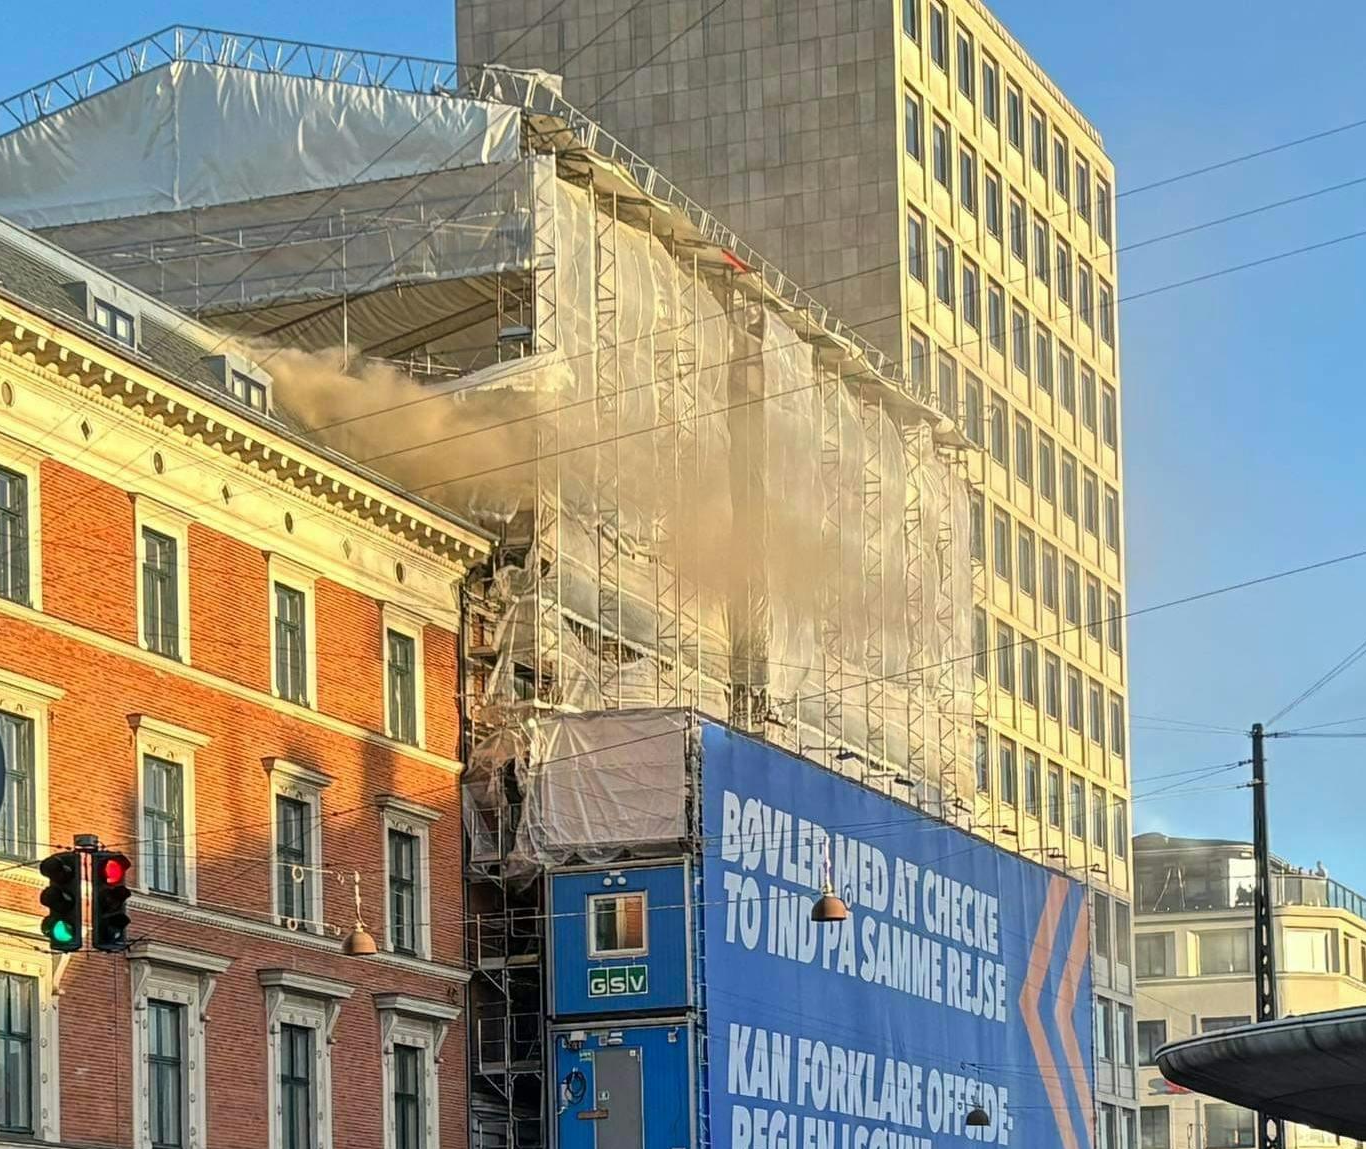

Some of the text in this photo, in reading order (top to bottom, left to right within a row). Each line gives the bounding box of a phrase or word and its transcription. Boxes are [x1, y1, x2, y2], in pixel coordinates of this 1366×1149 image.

[721, 790, 999, 955] BØVLER MED AT CHECKE
[591, 975, 644, 994] GSV
[723, 870, 761, 950] TO
[767, 884, 818, 963] IND
[860, 915, 942, 1004] SAMME
[947, 946, 1006, 1023] REJSE
[728, 1023, 791, 1104] KAN
[797, 1038, 923, 1129] FORKLARE
